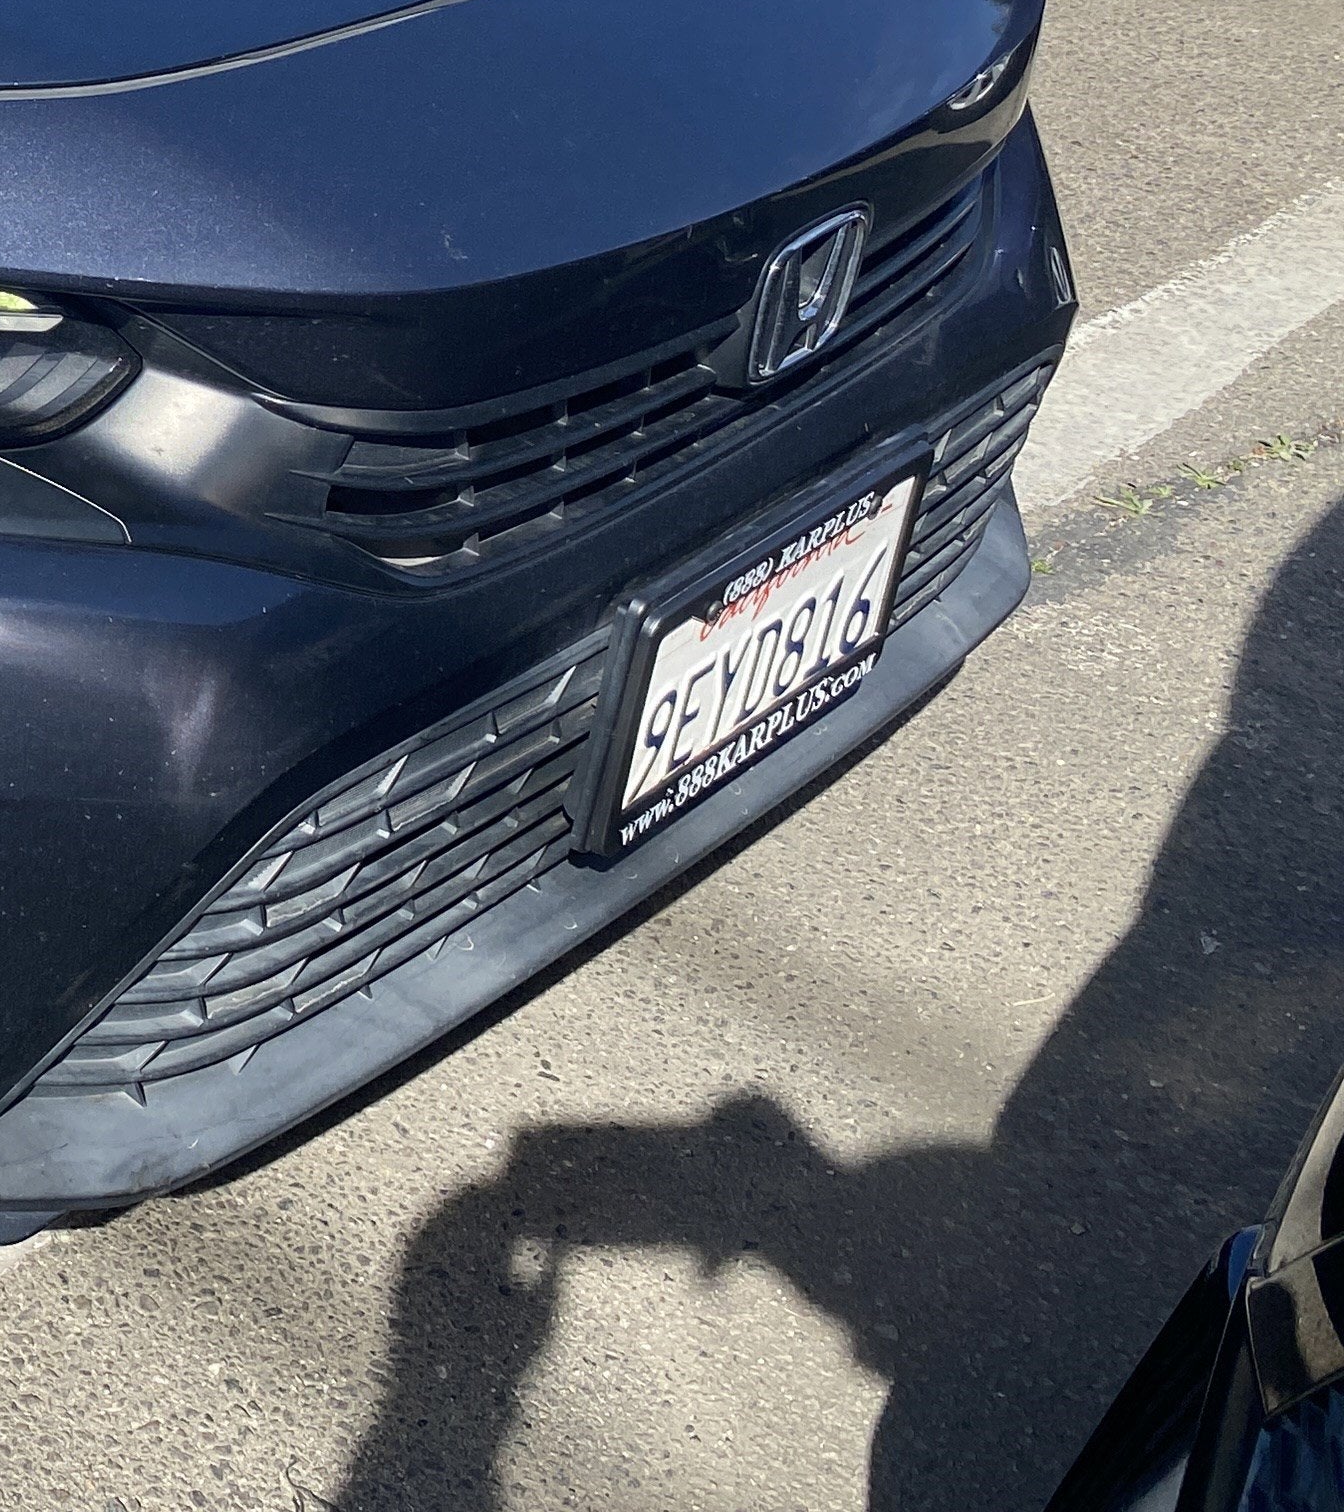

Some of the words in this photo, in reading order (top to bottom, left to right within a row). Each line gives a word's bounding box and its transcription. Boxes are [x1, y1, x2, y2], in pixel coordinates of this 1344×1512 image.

[723, 557, 774, 606] (888)
[775, 491, 875, 572] KARPLUS
[627, 543, 888, 808] 9EYD816
